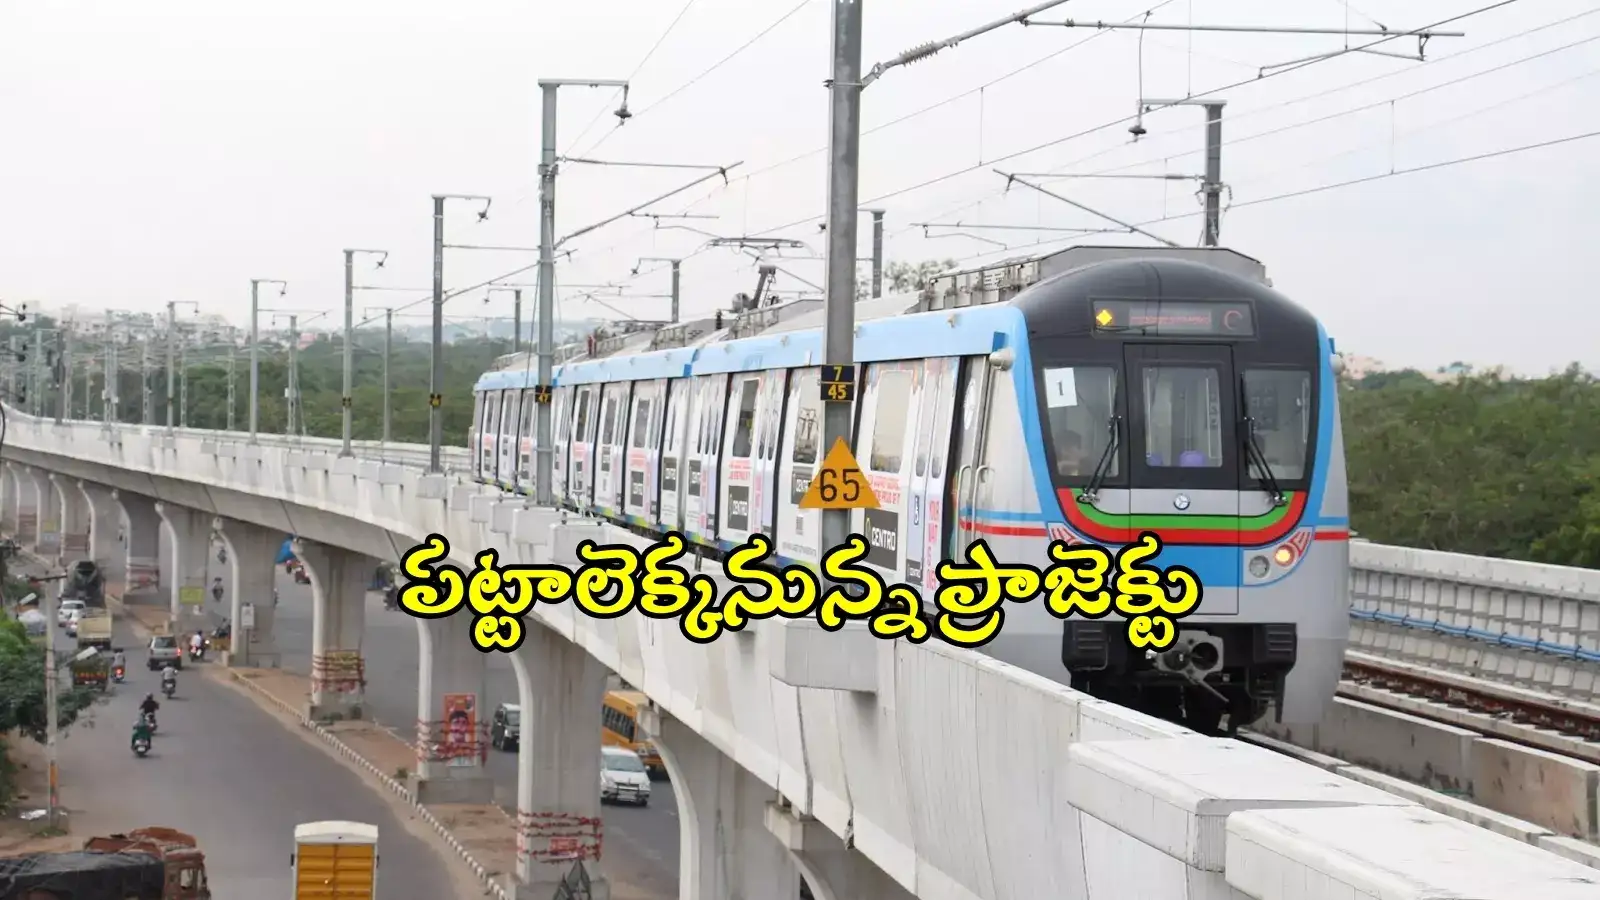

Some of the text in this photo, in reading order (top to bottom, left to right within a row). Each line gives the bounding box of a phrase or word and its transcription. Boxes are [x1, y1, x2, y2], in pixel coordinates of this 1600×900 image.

[833, 366, 842, 381] 7
[828, 384, 847, 400] 45
[820, 468, 861, 502] 65
[871, 526, 896, 551] CENTRO
